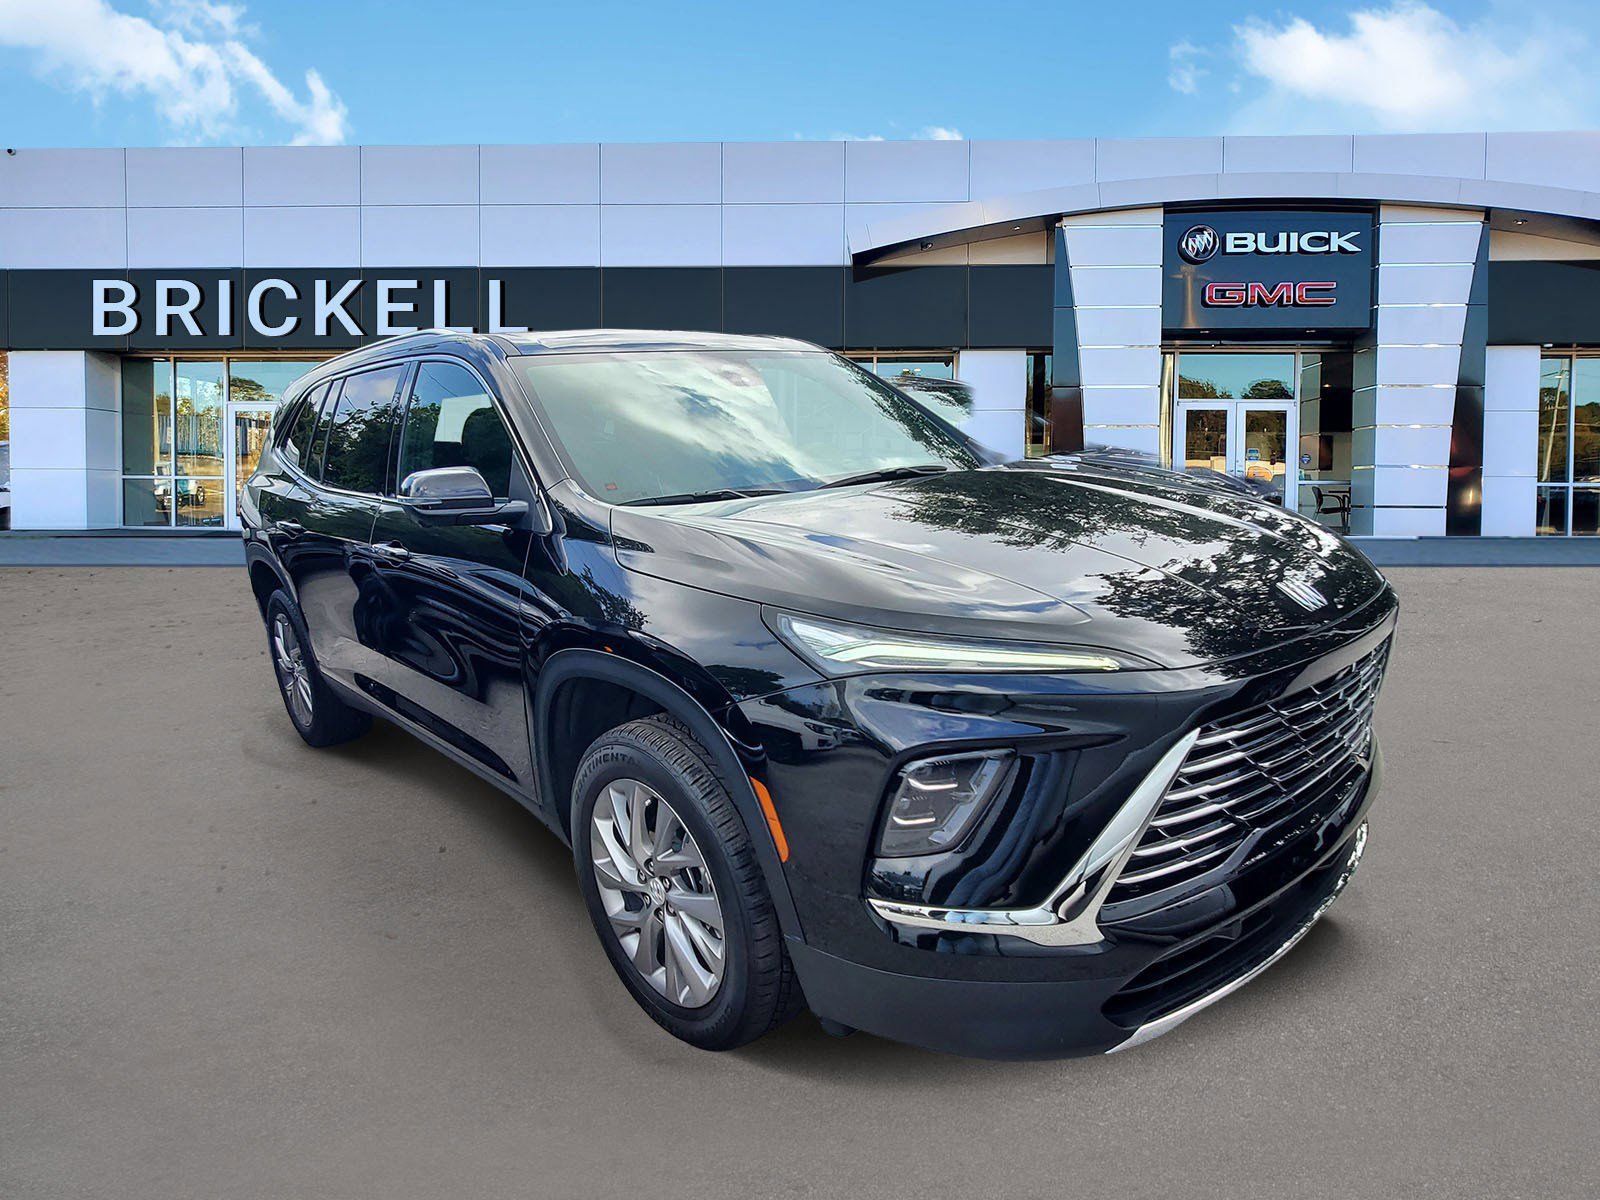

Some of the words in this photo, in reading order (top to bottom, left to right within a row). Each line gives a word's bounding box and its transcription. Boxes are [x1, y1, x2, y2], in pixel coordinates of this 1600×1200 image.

[1225, 231, 1362, 253] BUICK
[1205, 281, 1337, 305] GMC
[92, 278, 530, 336] BRICKELL
